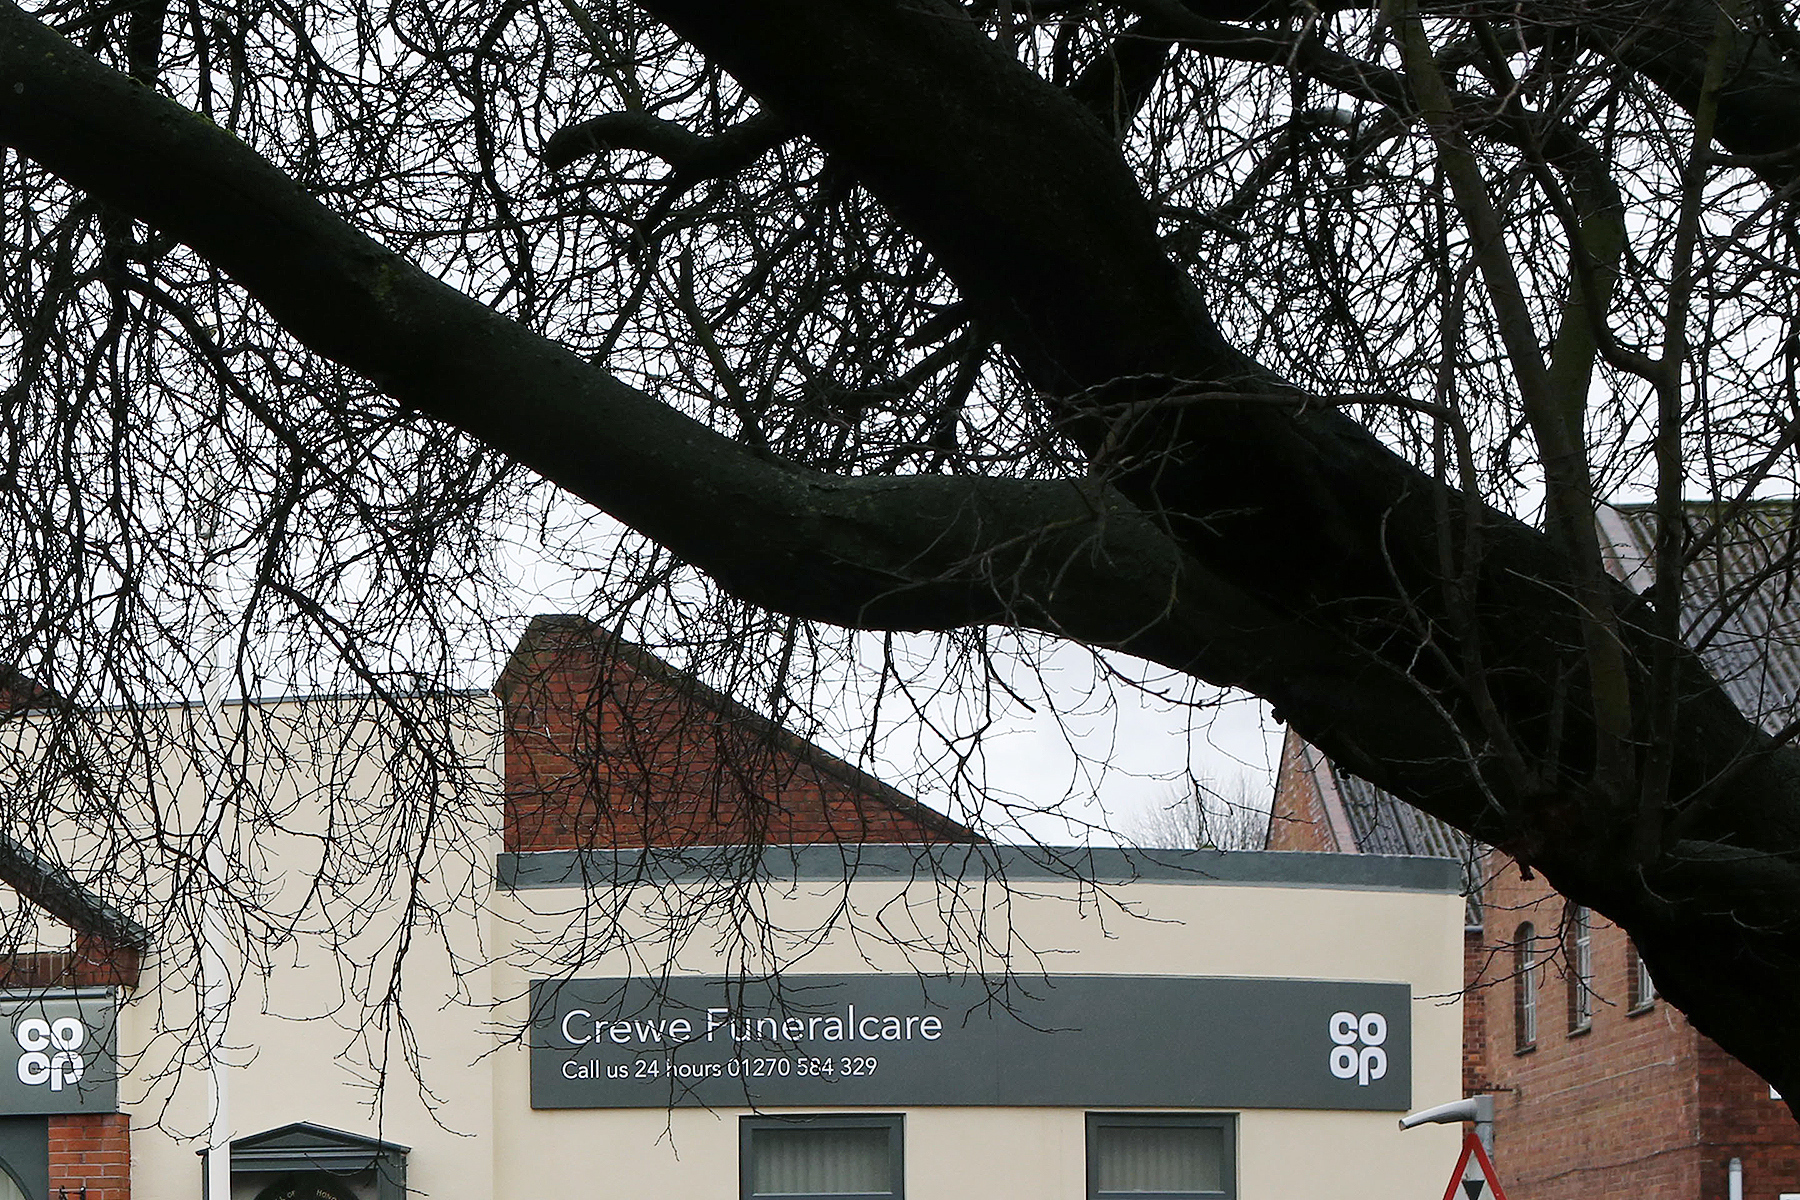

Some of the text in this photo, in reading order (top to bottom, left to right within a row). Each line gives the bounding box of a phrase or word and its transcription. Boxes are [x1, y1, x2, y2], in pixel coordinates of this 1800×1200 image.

[561, 1004, 943, 1045] Crewe Funeralcare
[562, 1056, 878, 1080] Call us 24 hours 01270 584 329
